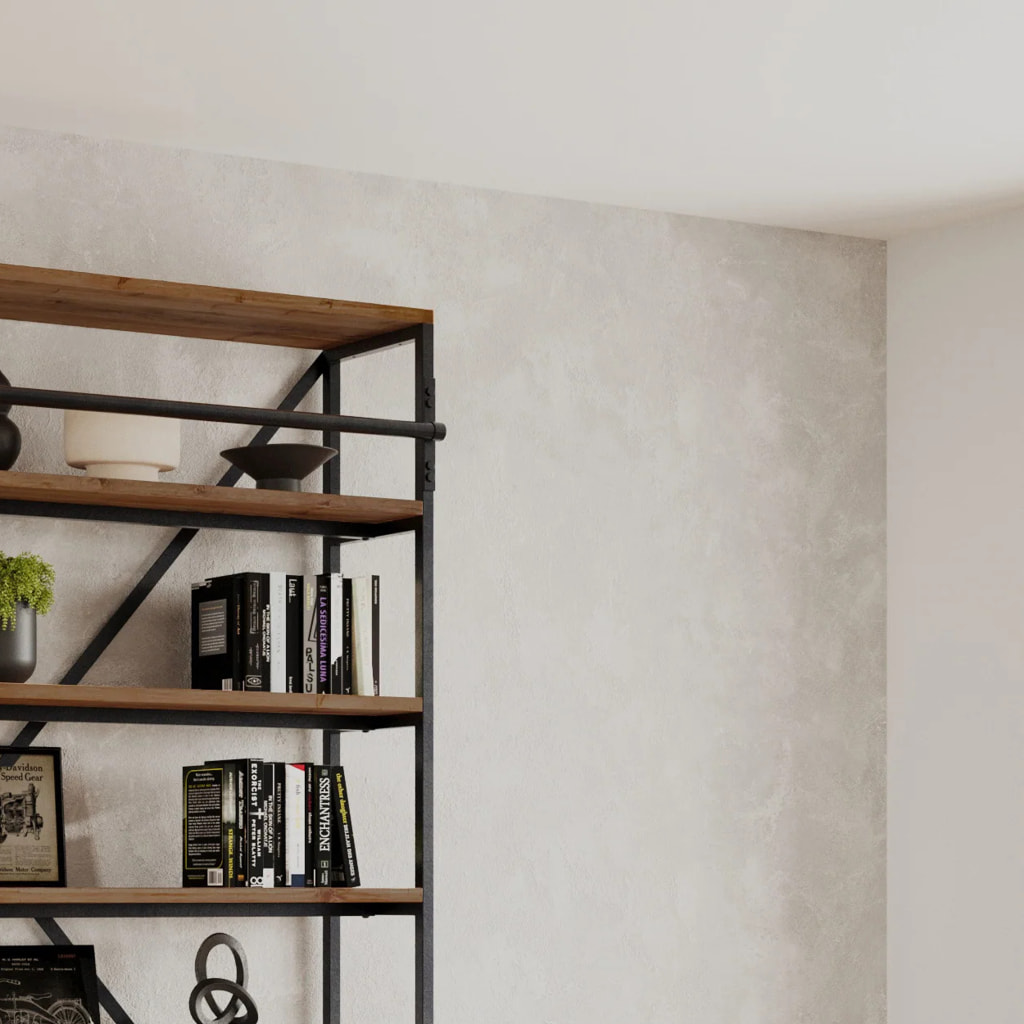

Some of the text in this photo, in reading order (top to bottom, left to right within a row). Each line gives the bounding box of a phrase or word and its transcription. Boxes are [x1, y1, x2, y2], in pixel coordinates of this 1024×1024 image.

[319, 597, 327, 608] LA
[319, 610, 327, 658] SEDICESIMA
[319, 660, 327, 682] LUNA
[1, 772, 23, 782] Speed
[24, 772, 43, 781] Gear
[319, 777, 330, 852] ENCHANTRESS
